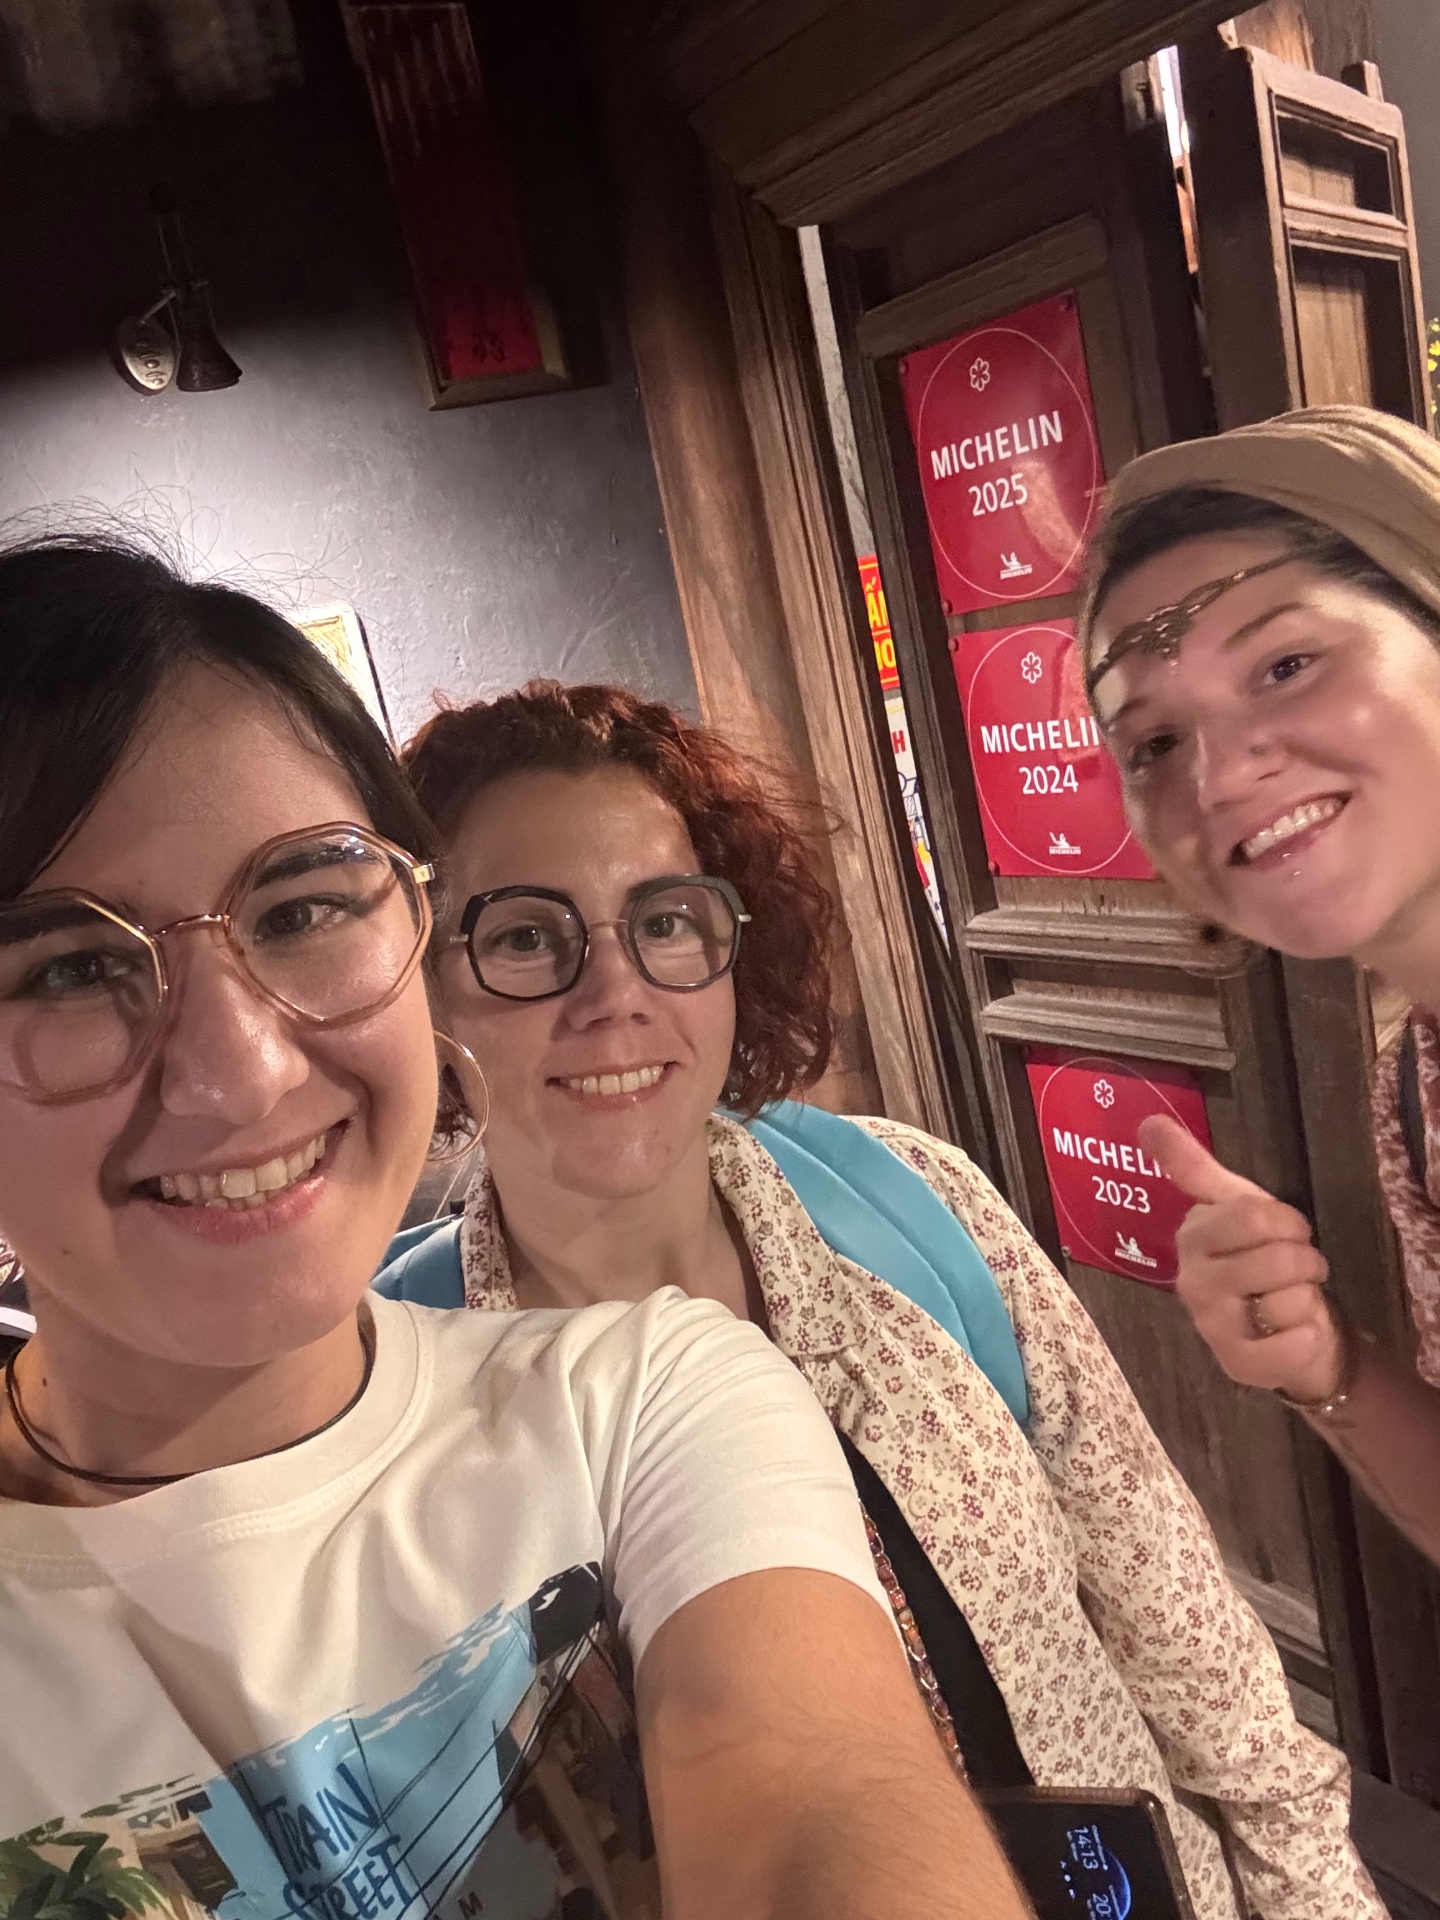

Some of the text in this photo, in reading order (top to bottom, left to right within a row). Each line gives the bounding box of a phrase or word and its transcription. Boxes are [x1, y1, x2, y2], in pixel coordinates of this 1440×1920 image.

[930, 410, 1063, 480] MICHELIN
[968, 472, 1028, 517] 2025
[1018, 764, 1080, 795] 2024
[1052, 1126, 1172, 1181] MICHELI
[1091, 1175, 1151, 1214] 2023
[261, 1762, 382, 1876] TRAIN
[1074, 1825, 1099, 1870] 14:13
